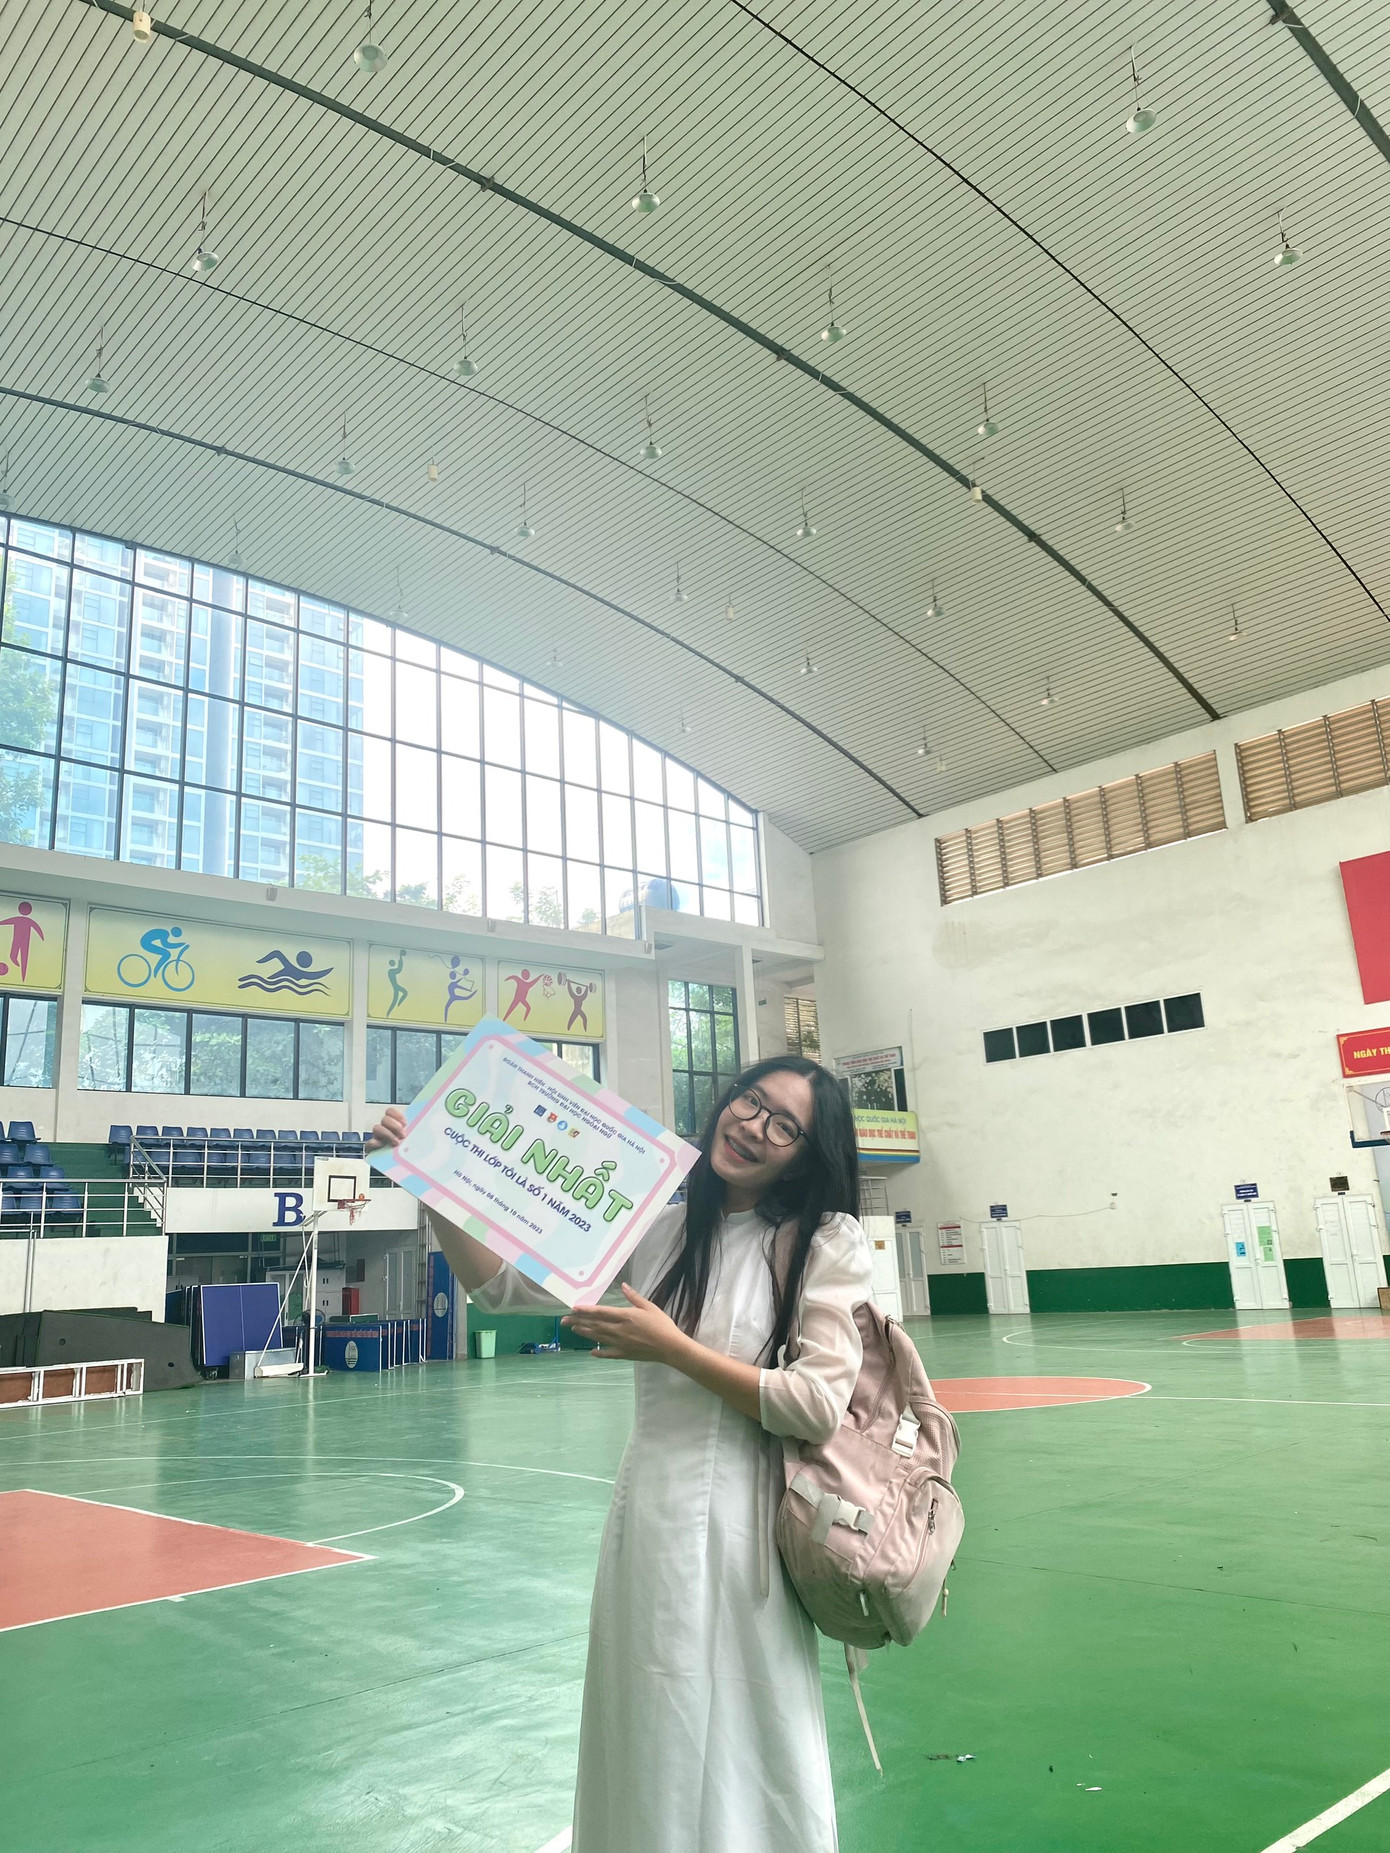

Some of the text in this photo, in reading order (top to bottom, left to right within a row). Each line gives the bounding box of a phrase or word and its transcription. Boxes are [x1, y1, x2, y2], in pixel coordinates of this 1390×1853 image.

[1353, 1048, 1377, 1059] NGÀY
[502, 1057, 517, 1068] ĐOÀN
[517, 1066, 534, 1080] THANH
[557, 1092, 569, 1103] SINH
[590, 1113, 601, 1124] HỌC
[602, 1122, 617, 1134] QUỐC
[617, 1132, 627, 1142] GIA
[527, 1081, 538, 1091] BCH
[569, 1107, 582, 1118] HỌC
[444, 1087, 634, 1224] GIẢI NHẤT
[444, 1127, 592, 1233] CUỘC THI LỚP TÔI LÀ SỐ 1 NĂM 2023
[472, 1183, 487, 1195] ngày
[494, 1197, 510, 1212] tháng
[272, 1192, 304, 1227] B
